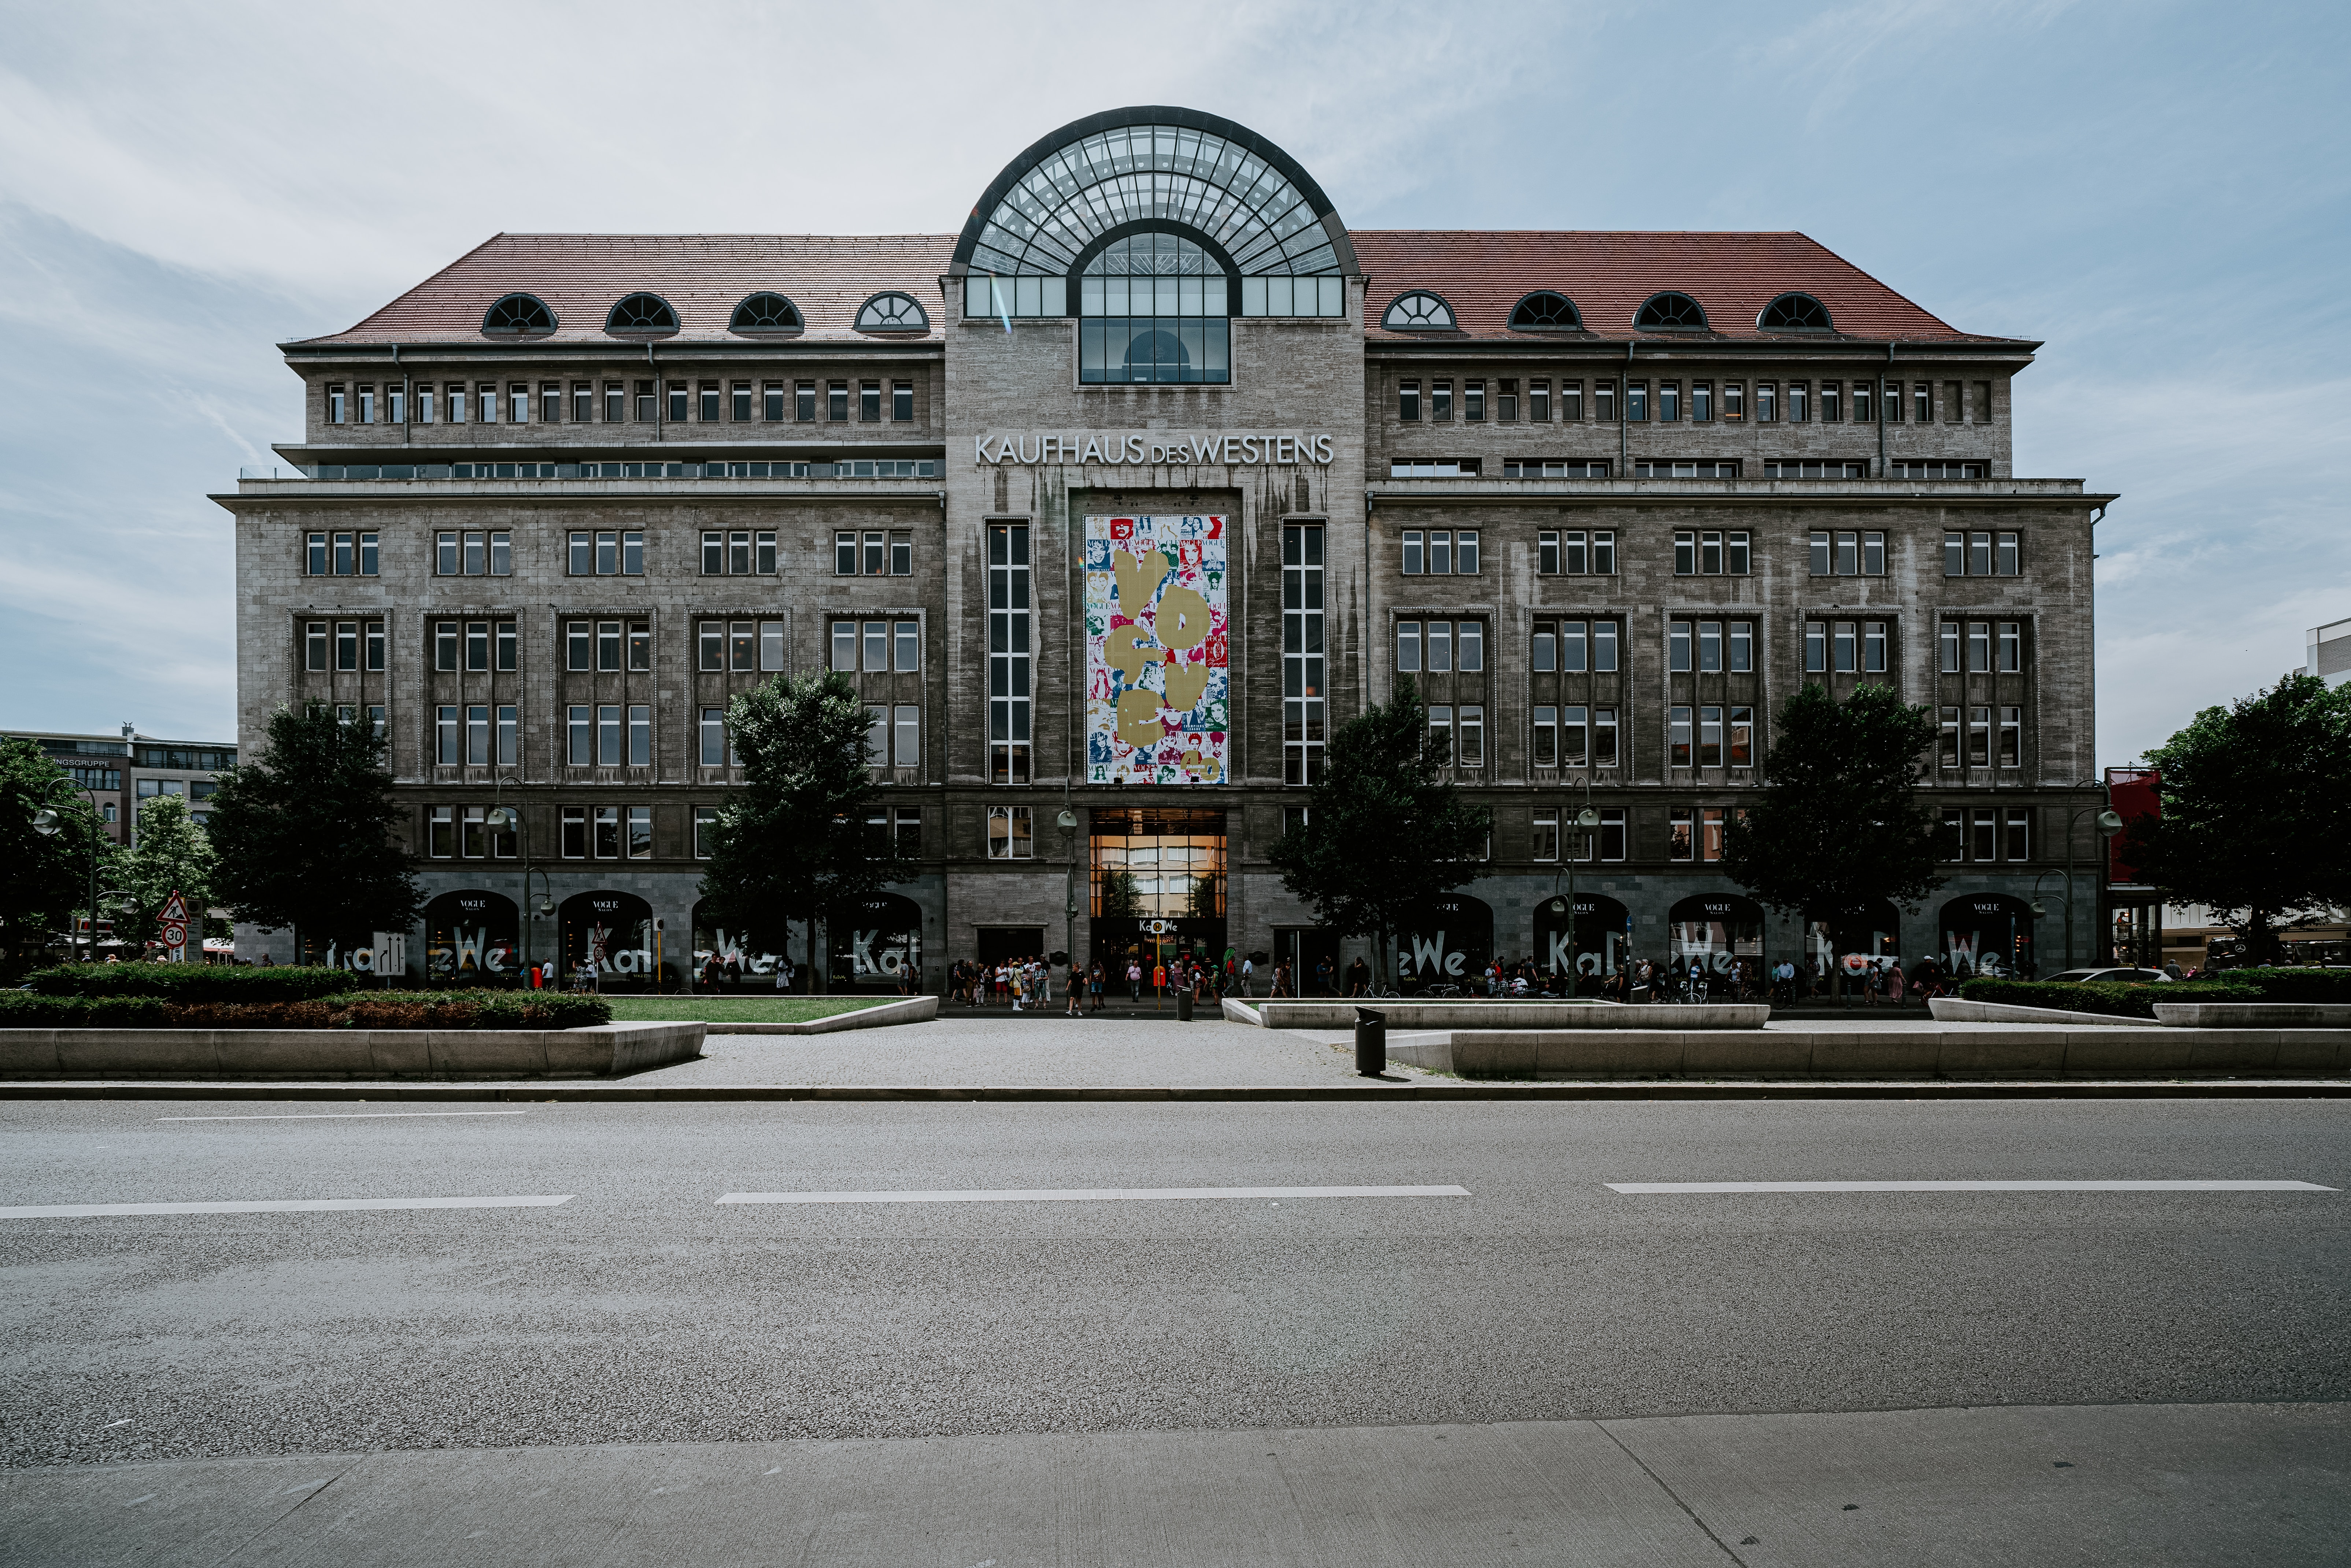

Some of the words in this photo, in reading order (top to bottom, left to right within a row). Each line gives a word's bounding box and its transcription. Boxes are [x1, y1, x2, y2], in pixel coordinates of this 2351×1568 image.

[976, 434, 1145, 465] KAUFHAUS
[1151, 444, 1190, 465] DES
[1189, 434, 1334, 465] WESTENS
[1180, 750, 1220, 781] 40
[1139, 920, 1178, 931] KaWe
[167, 929, 182, 941] 30
[596, 949, 603, 957] 30
